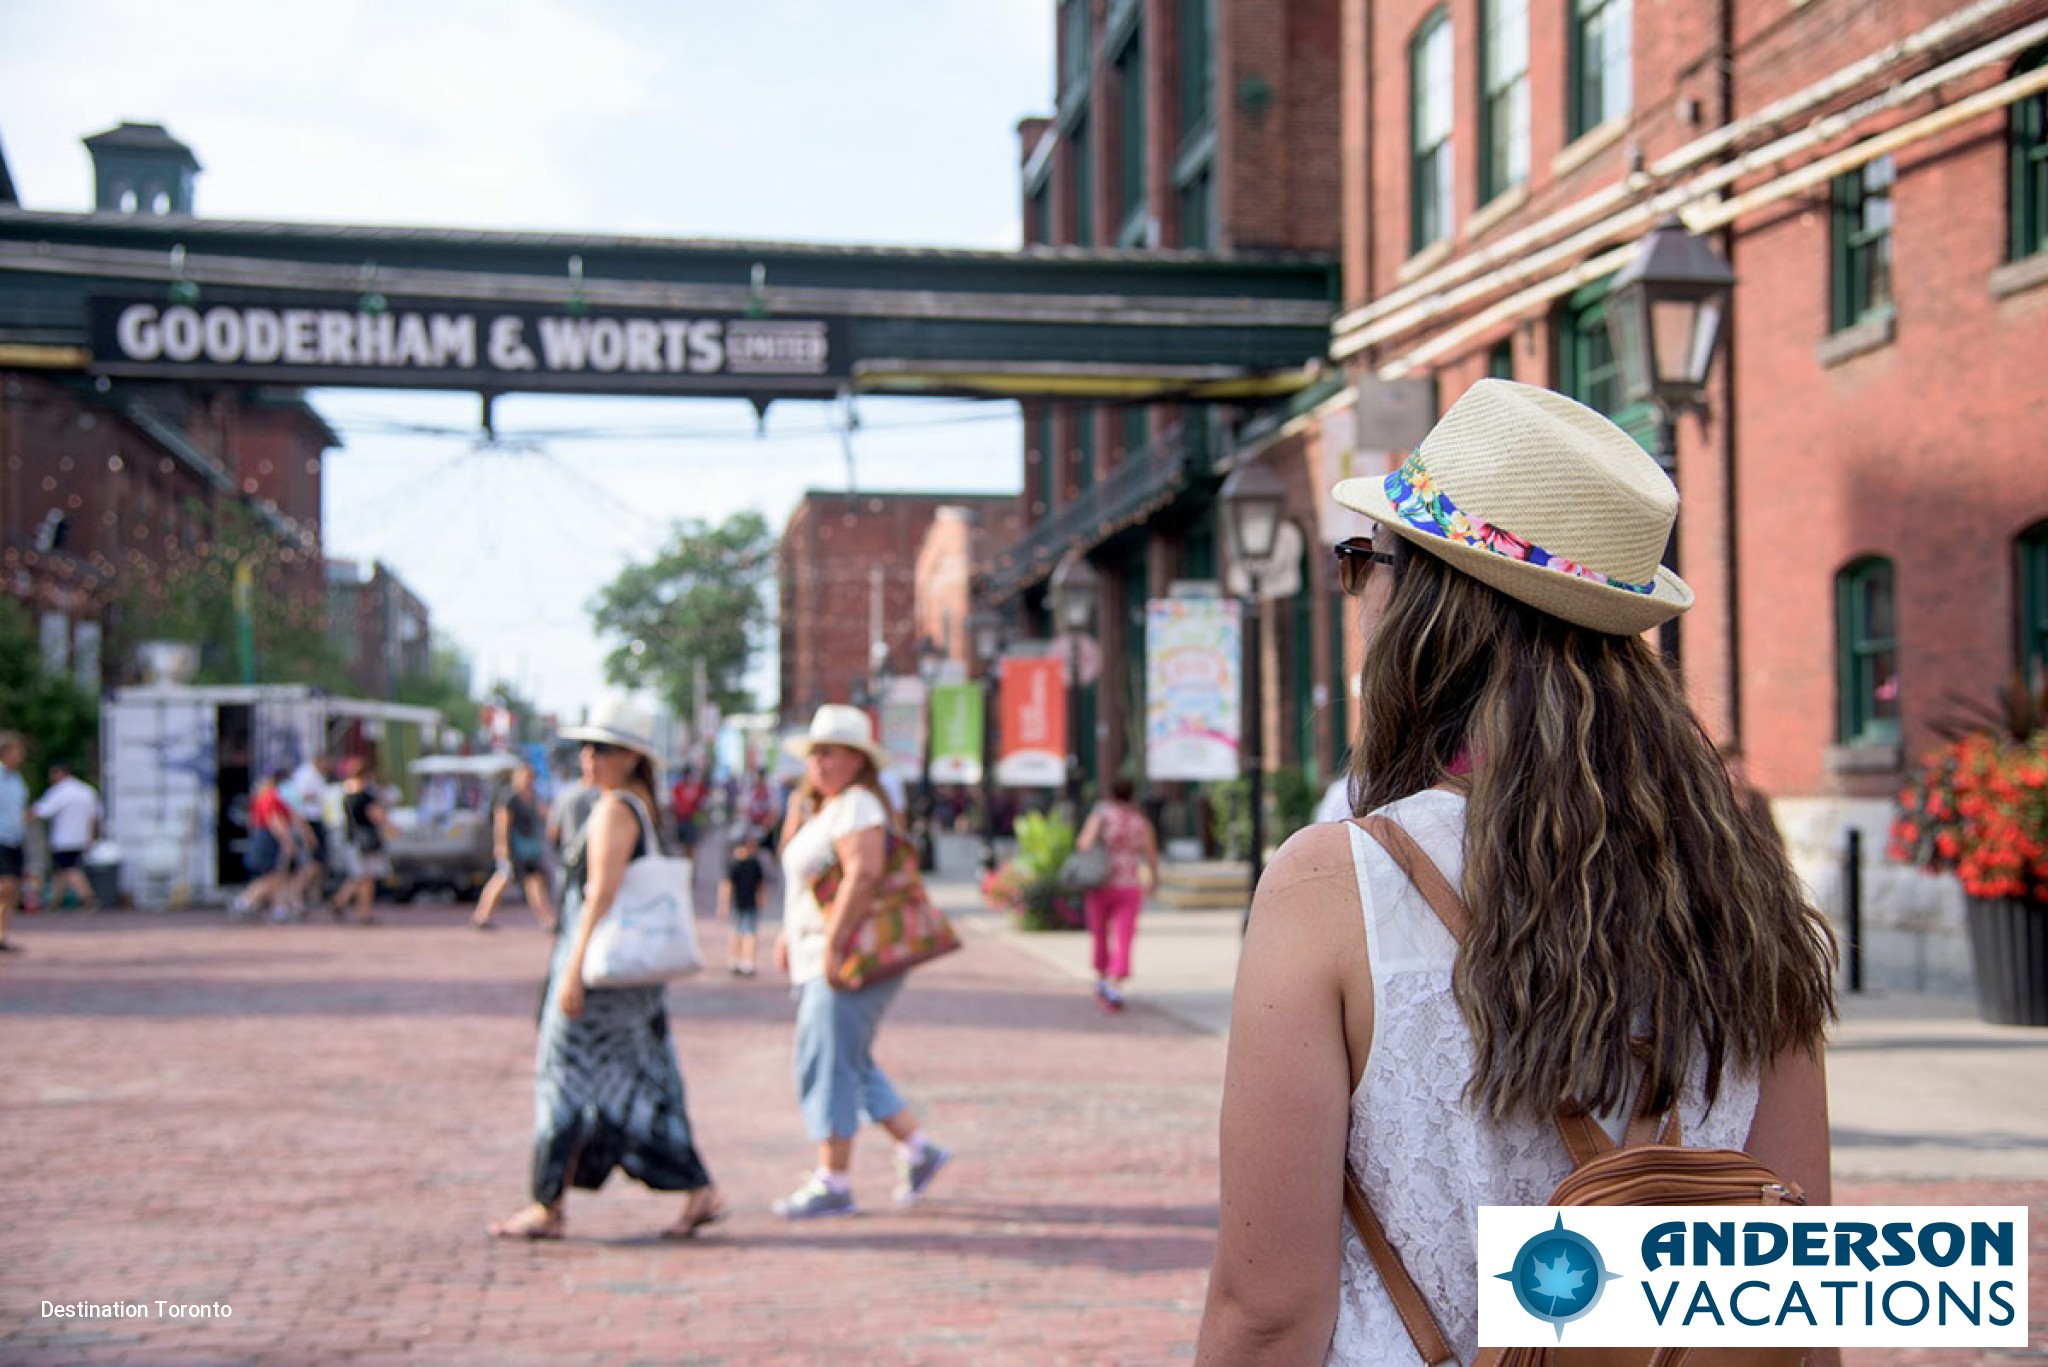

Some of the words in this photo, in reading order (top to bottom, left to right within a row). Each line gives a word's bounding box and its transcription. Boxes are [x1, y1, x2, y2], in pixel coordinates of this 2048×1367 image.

[117, 304, 476, 368] GOODERHAM
[487, 315, 537, 371] &
[538, 316, 723, 374] WORTS
